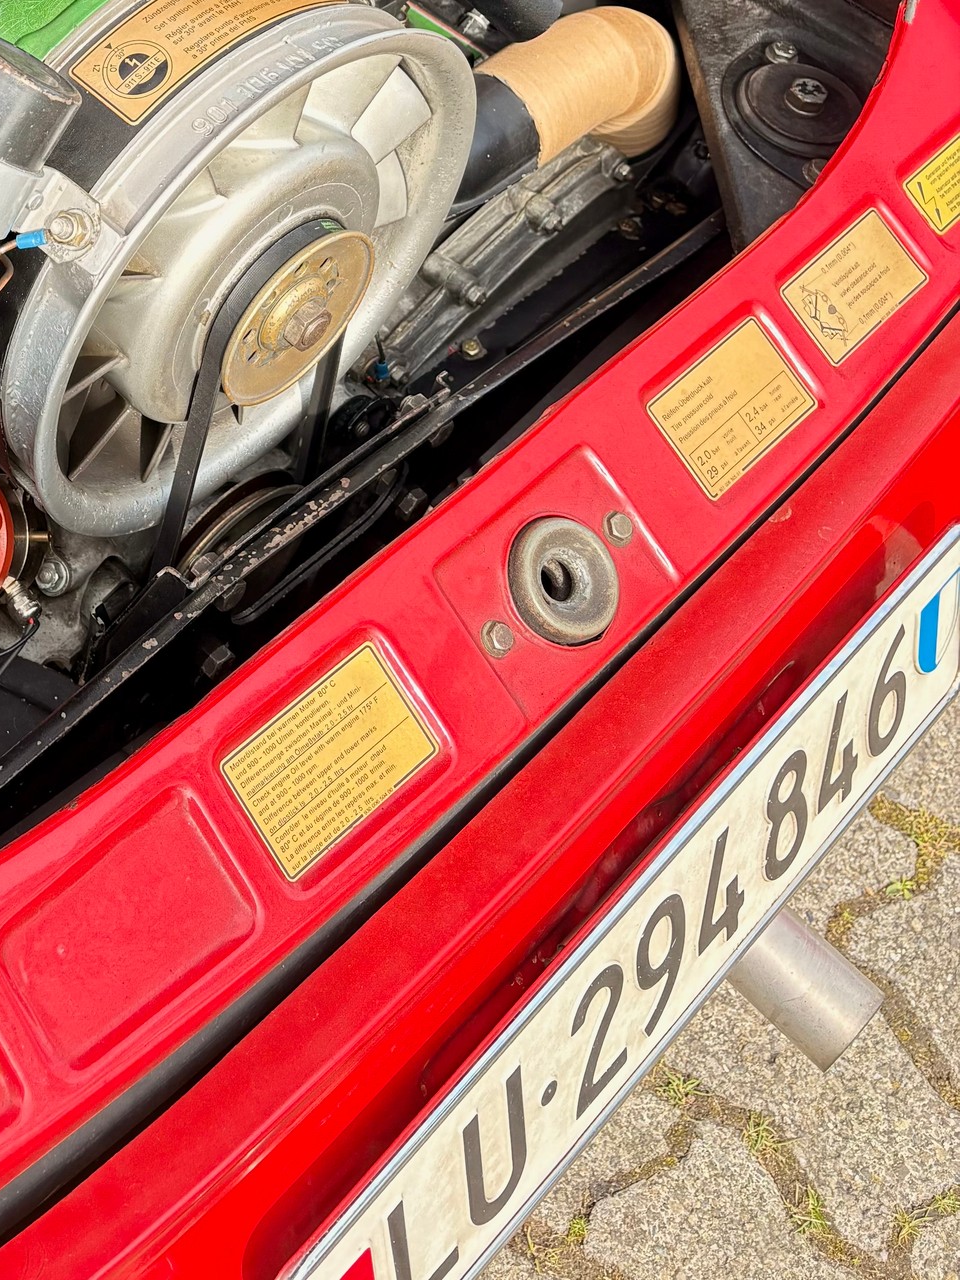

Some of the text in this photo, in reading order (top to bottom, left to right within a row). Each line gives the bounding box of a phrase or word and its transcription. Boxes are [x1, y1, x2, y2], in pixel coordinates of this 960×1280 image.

[153, 20, 168, 32] Set
[166, 4, 194, 23] ignition
[164, 22, 193, 41] Régler
[189, 7, 217, 24] avance
[172, 35, 185, 46] sur
[181, 25, 196, 37] 30°
[197, 13, 218, 28] avant
[182, 19, 236, 55] Regolare punto
[195, 23, 241, 55] 30° prima del
[124, 61, 157, 90] 911 911
[192, 97, 239, 137] 901
[867, 262, 877, 273] cold
[853, 292, 862, 302] des
[701, 375, 713, 387] kalt
[670, 392, 714, 432] Tire pressure cold
[678, 389, 738, 445] Pression des pneus froid
[745, 406, 760, 423] 2,4
[754, 421, 767, 436] 34
[696, 445, 721, 467] 2,0 bar
[706, 460, 729, 480] 29 psi
[229, 684, 329, 772] Motorölstand bei warmen Motor 80°
[239, 750, 285, 789] Differenzmenge
[284, 728, 311, 753] zwischen
[309, 707, 334, 731] Maximal
[336, 696, 348, 708] und
[235, 767, 248, 781] und
[246, 757, 259, 770] 900
[262, 742, 277, 757] 1000
[252, 700, 373, 808] Check engine Oil level with warm engine 175°
[246, 762, 287, 799] malmarkierung
[285, 754, 296, 765] am
[262, 725, 377, 826] Difference between upper and lower marks
[301, 813, 309, 821] le
[308, 797, 328, 816] niveau
[349, 760, 369, 780] moteur
[370, 744, 387, 762] chaud
[258, 803, 270, 817] and
[269, 798, 277, 807] at
[275, 787, 289, 801] 900
[291, 772, 306, 787] 1000
[269, 825, 278, 835] on
[277, 805, 300, 828] dipstick
[279, 839, 291, 854] 80°
[332, 799, 340, 808] de
[339, 788, 352, 801] 900
[355, 773, 369, 788] 1000
[285, 853, 295, 863] La
[294, 829, 322, 855] difference
[321, 816, 336, 831] entre
[334, 809, 346, 819] les
[378, 772, 386, 780] et
[291, 825, 341, 872] sur la jauge est de
